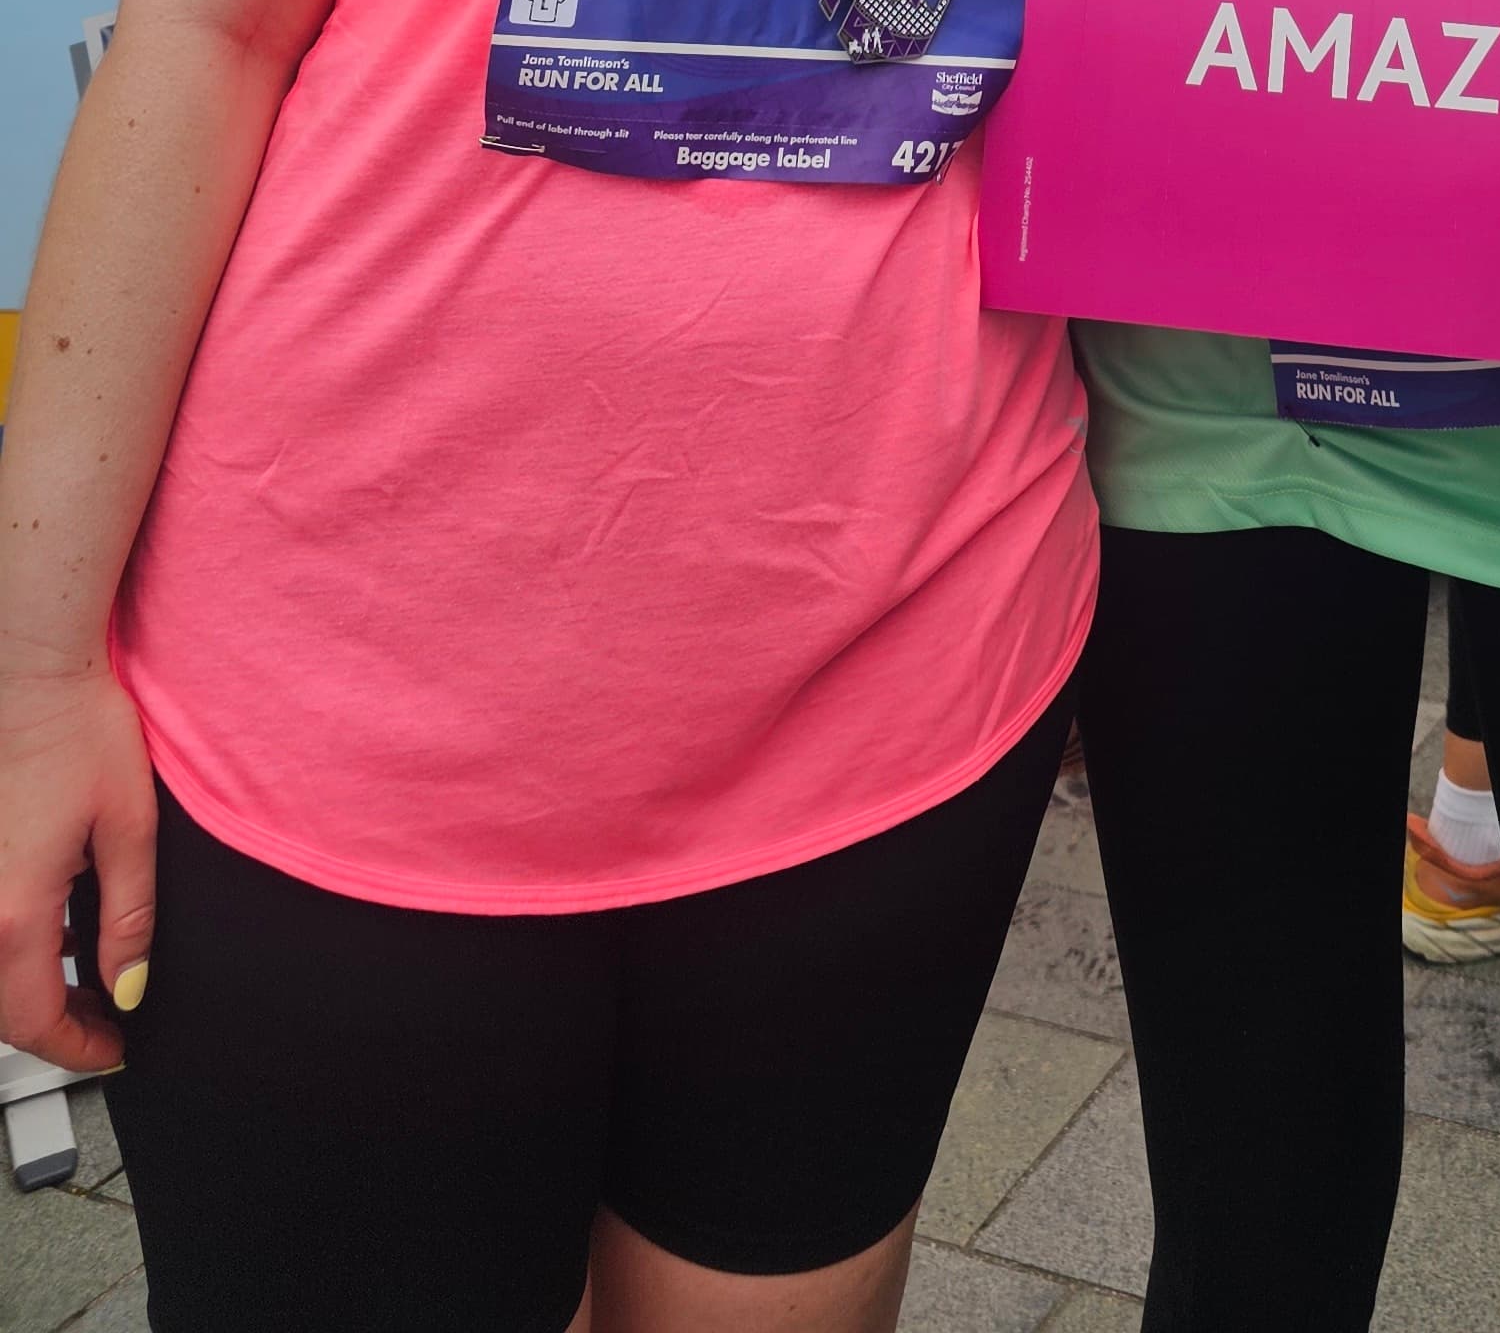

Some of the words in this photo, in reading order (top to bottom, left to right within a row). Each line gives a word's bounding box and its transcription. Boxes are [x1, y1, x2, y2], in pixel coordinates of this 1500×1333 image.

[522, 53, 554, 67] Jane
[558, 55, 630, 70] Tomlinson's
[518, 68, 570, 89] RUN
[573, 71, 620, 92] FOR
[623, 73, 664, 93] ALL
[935, 71, 983, 85] Sheffield
[496, 114, 514, 126] Pull
[516, 119, 534, 129] end
[536, 122, 547, 131] of
[548, 124, 572, 135] label
[574, 126, 612, 139] through
[615, 129, 629, 139] slit
[653, 130, 684, 141] Please
[685, 132, 703, 141] tear
[704, 132, 743, 145] carefully
[745, 133, 771, 145] along
[773, 133, 789, 143] the
[790, 134, 839, 146] perforated
[840, 135, 858, 145] line
[676, 146, 770, 171] Baggage
[776, 148, 831, 169] label
[1295, 369, 1318, 381] Jane
[1320, 371, 1370, 385] Tomlinson's
[1296, 382, 1332, 402] RUN
[1335, 385, 1367, 405] FOR
[1370, 390, 1400, 408] ALL
